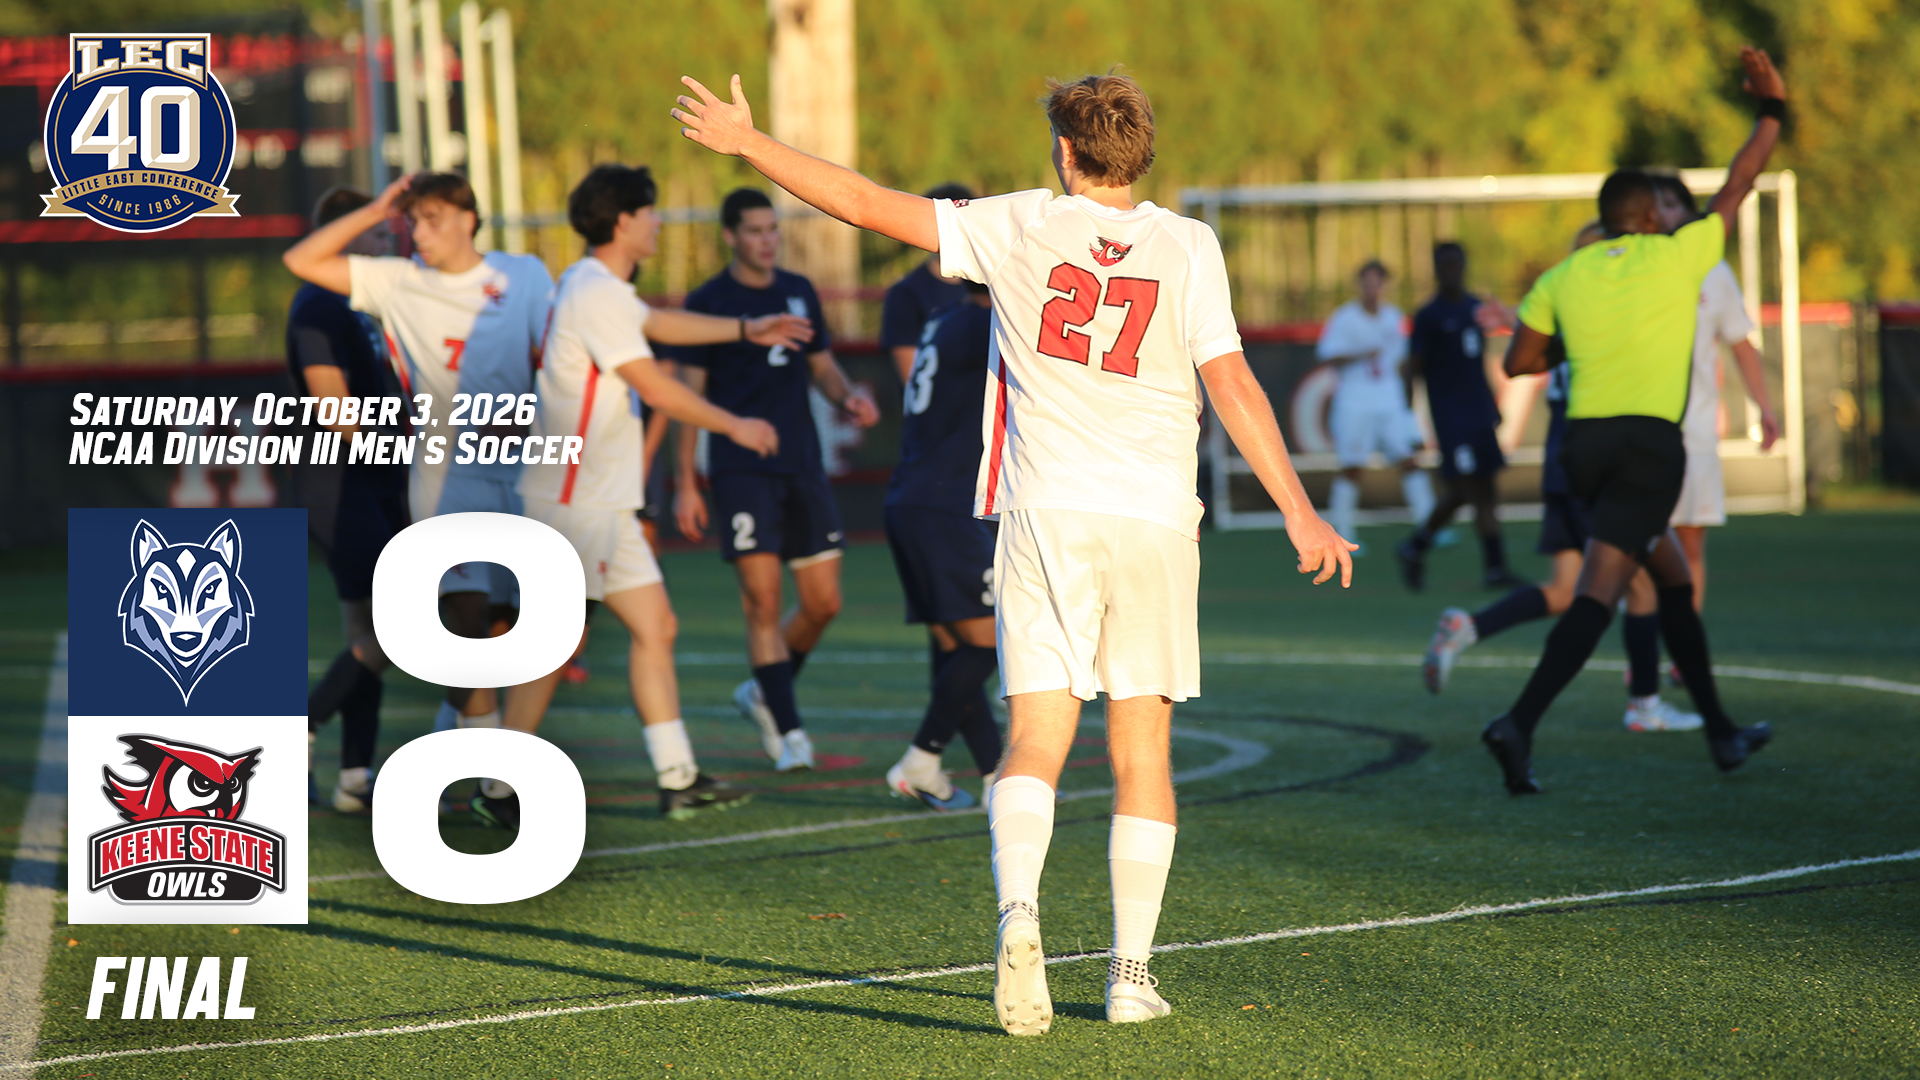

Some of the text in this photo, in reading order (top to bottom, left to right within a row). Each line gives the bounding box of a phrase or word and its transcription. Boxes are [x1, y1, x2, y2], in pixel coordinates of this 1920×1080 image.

[1036, 261, 1160, 378] 27
[443, 338, 466, 372] 7
[731, 511, 758, 551] 2
